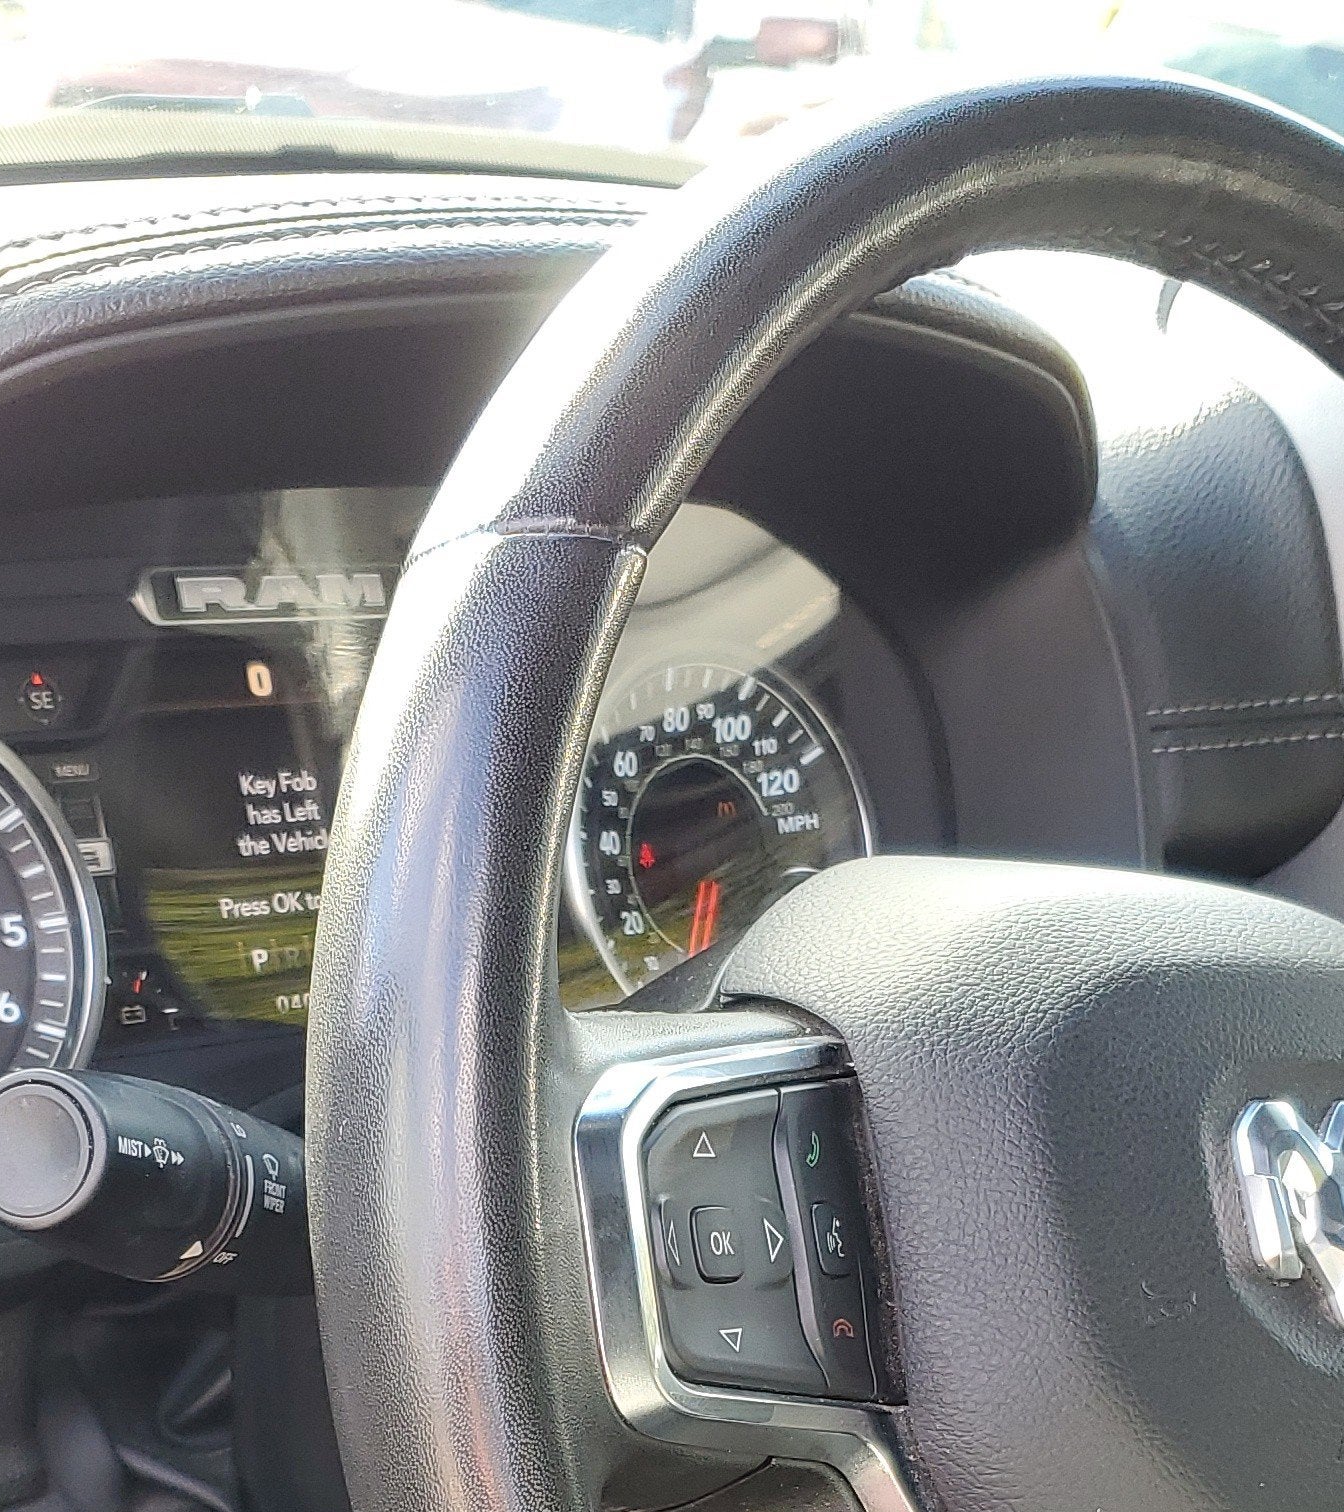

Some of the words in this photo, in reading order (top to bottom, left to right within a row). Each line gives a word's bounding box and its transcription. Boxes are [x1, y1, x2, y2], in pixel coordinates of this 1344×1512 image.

[175, 573, 387, 613] RAM
[246, 661, 274, 698] 0
[29, 691, 55, 710] SE
[662, 706, 691, 733] 80
[712, 713, 752, 744] 100
[639, 725, 655, 742] 70
[752, 737, 779, 757] 110
[613, 750, 639, 777] 60
[238, 771, 277, 799] Key
[277, 769, 318, 794] Fob
[757, 767, 801, 798] 120
[246, 803, 283, 825] has
[282, 799, 322, 824] Left
[776, 812, 820, 835] MPH
[235, 834, 272, 858] the
[271, 828, 329, 854] Vehicl
[599, 830, 622, 856] 40
[218, 897, 272, 919] Press
[272, 890, 305, 914] OK
[619, 910, 645, 936] 20
[251, 948, 269, 974] P
[118, 1135, 144, 1159] MIST
[263, 1178, 287, 1200] FRONT
[263, 1194, 286, 1215] WIPER
[710, 1231, 735, 1255] OK
[212, 1251, 239, 1265] OFF
